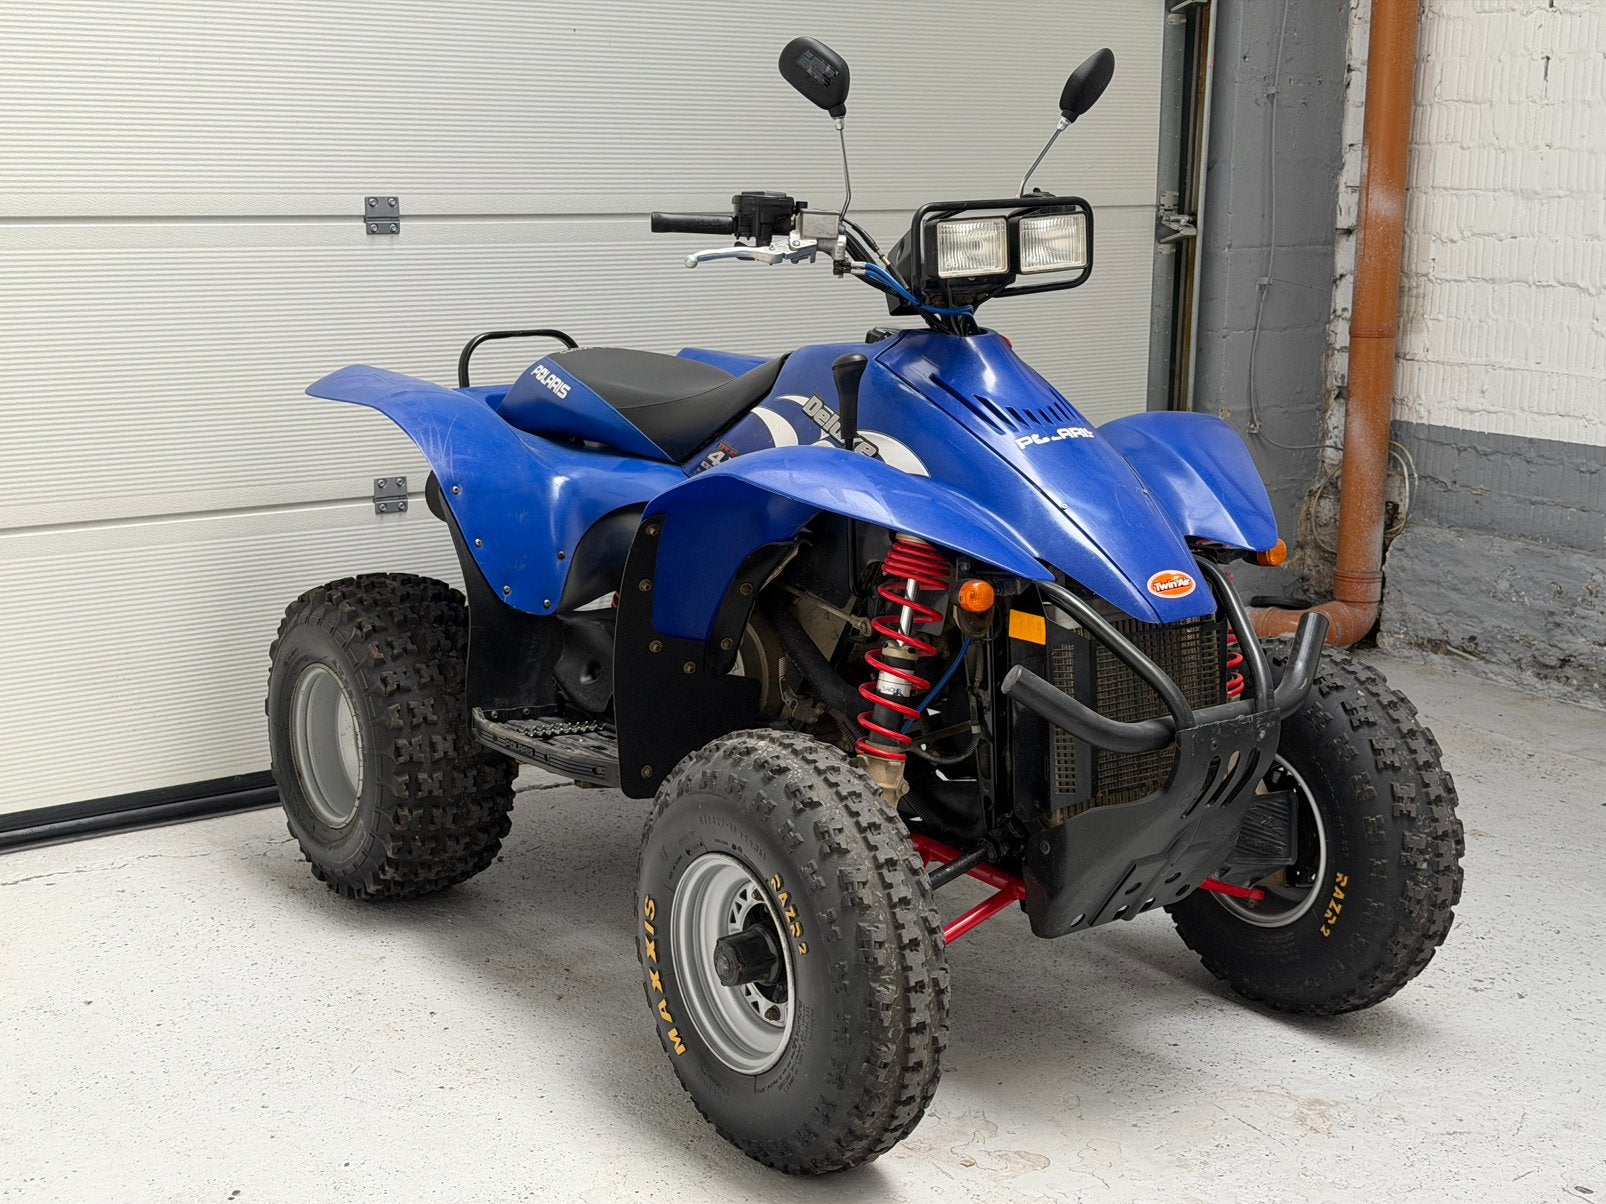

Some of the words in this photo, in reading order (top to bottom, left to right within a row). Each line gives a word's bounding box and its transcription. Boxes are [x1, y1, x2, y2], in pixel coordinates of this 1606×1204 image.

[531, 364, 572, 400] POLARIS
[802, 394, 879, 459] Delue
[1015, 427, 1095, 450] POLARIS
[1324, 872, 1348, 925] RAZR
[1320, 924, 1331, 937] 2
[644, 895, 687, 1056] MAXXIS
